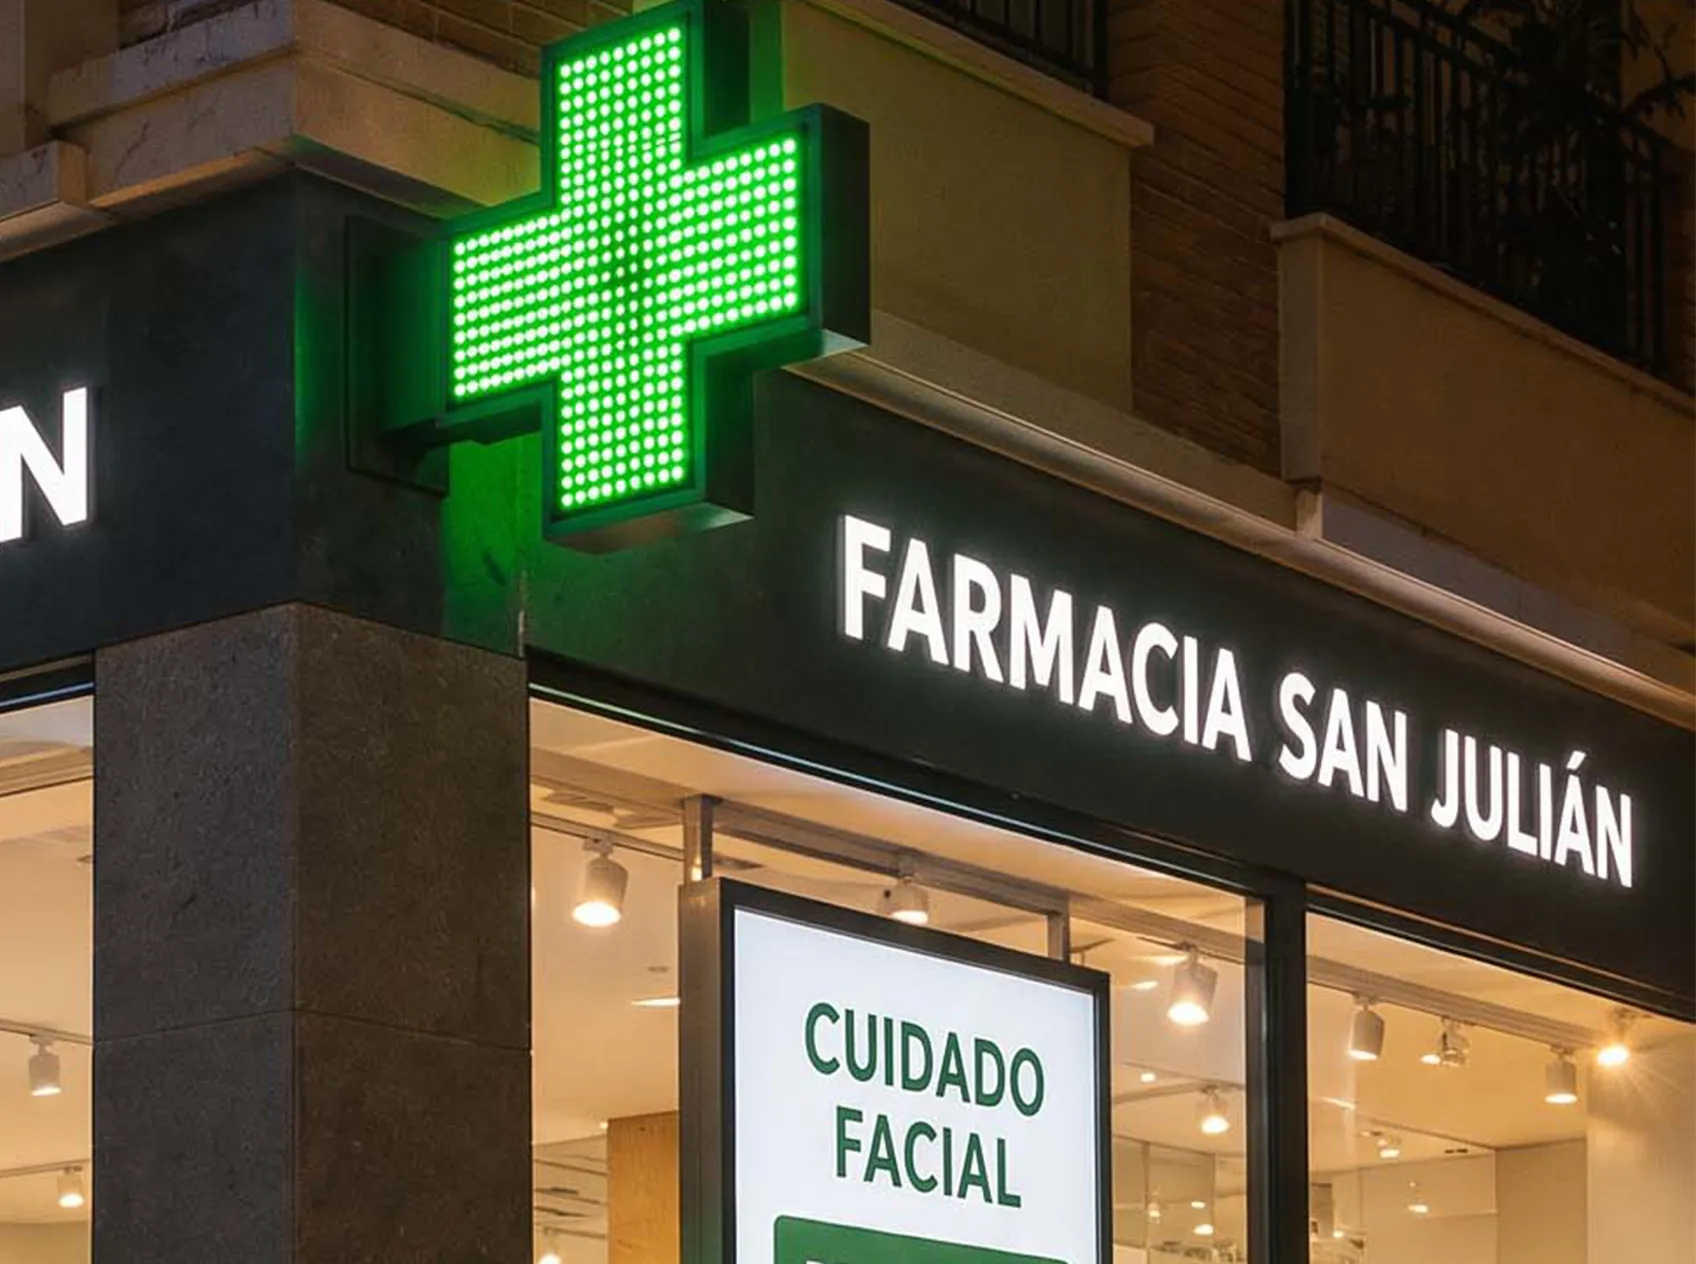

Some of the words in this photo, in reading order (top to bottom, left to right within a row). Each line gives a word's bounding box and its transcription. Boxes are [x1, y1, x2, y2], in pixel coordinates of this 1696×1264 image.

[843, 514, 1252, 762] FARMACIA
[1278, 671, 1408, 812] SAN
[1430, 728, 1633, 888] JULIÁN
[804, 1001, 1045, 1117] CUIDADO
[834, 1104, 1022, 1209] FACIAL
